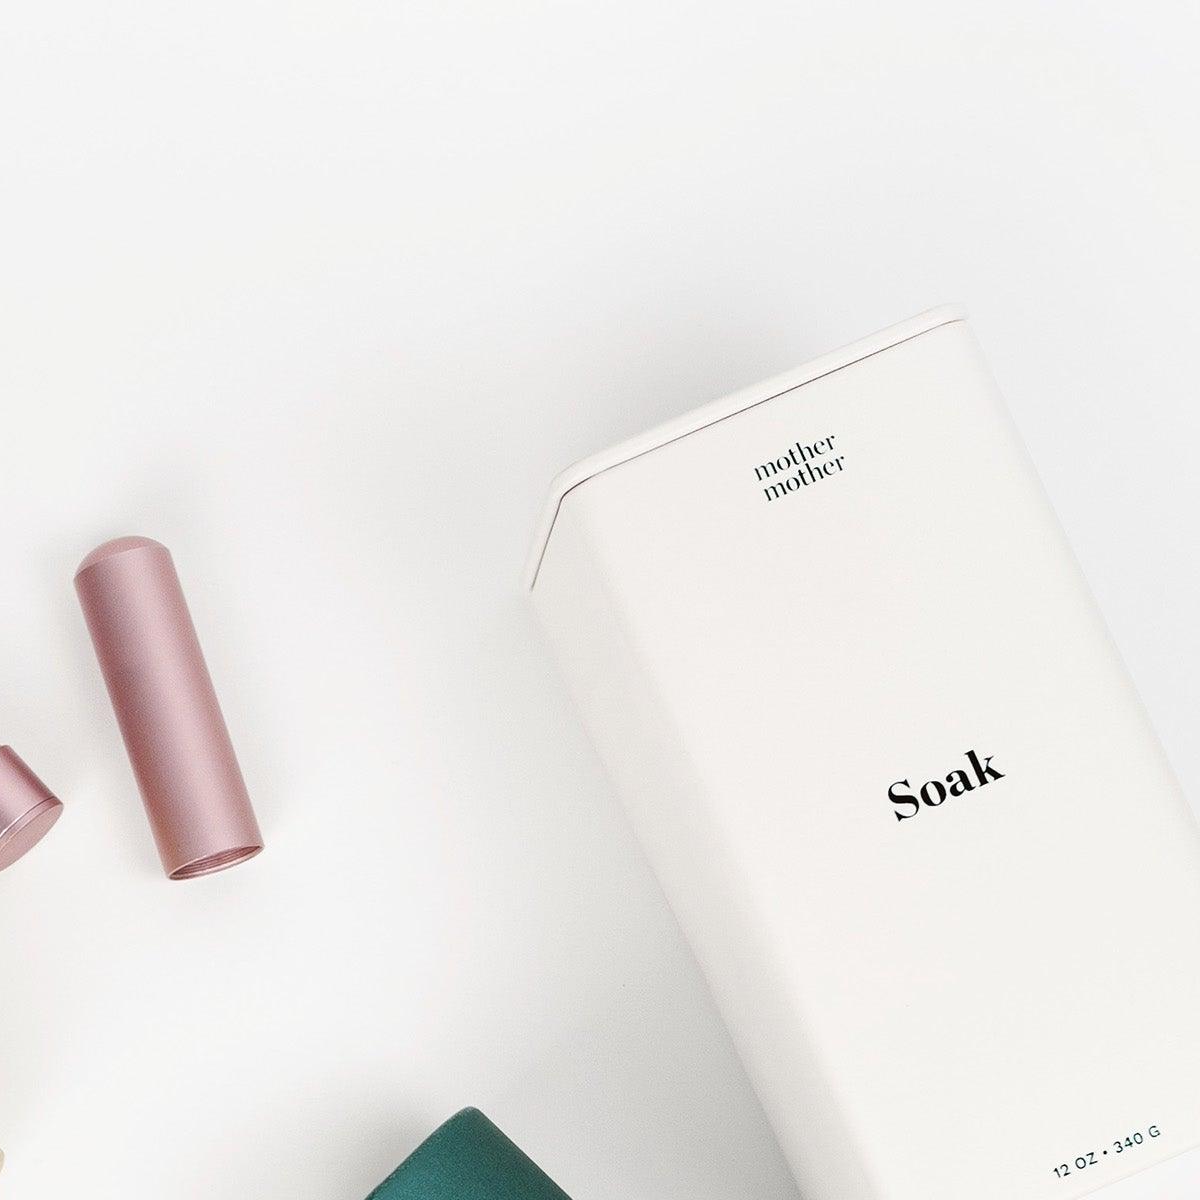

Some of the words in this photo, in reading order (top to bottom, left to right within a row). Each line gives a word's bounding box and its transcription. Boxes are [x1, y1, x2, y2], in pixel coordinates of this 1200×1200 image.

[754, 435, 835, 481] mother
[764, 456, 844, 501] mother
[887, 749, 1006, 822] Soak
[1053, 1163, 1071, 1178] 12
[1075, 1152, 1098, 1169] OZ
[1113, 1132, 1144, 1153] 340
[1148, 1125, 1161, 1138] G
